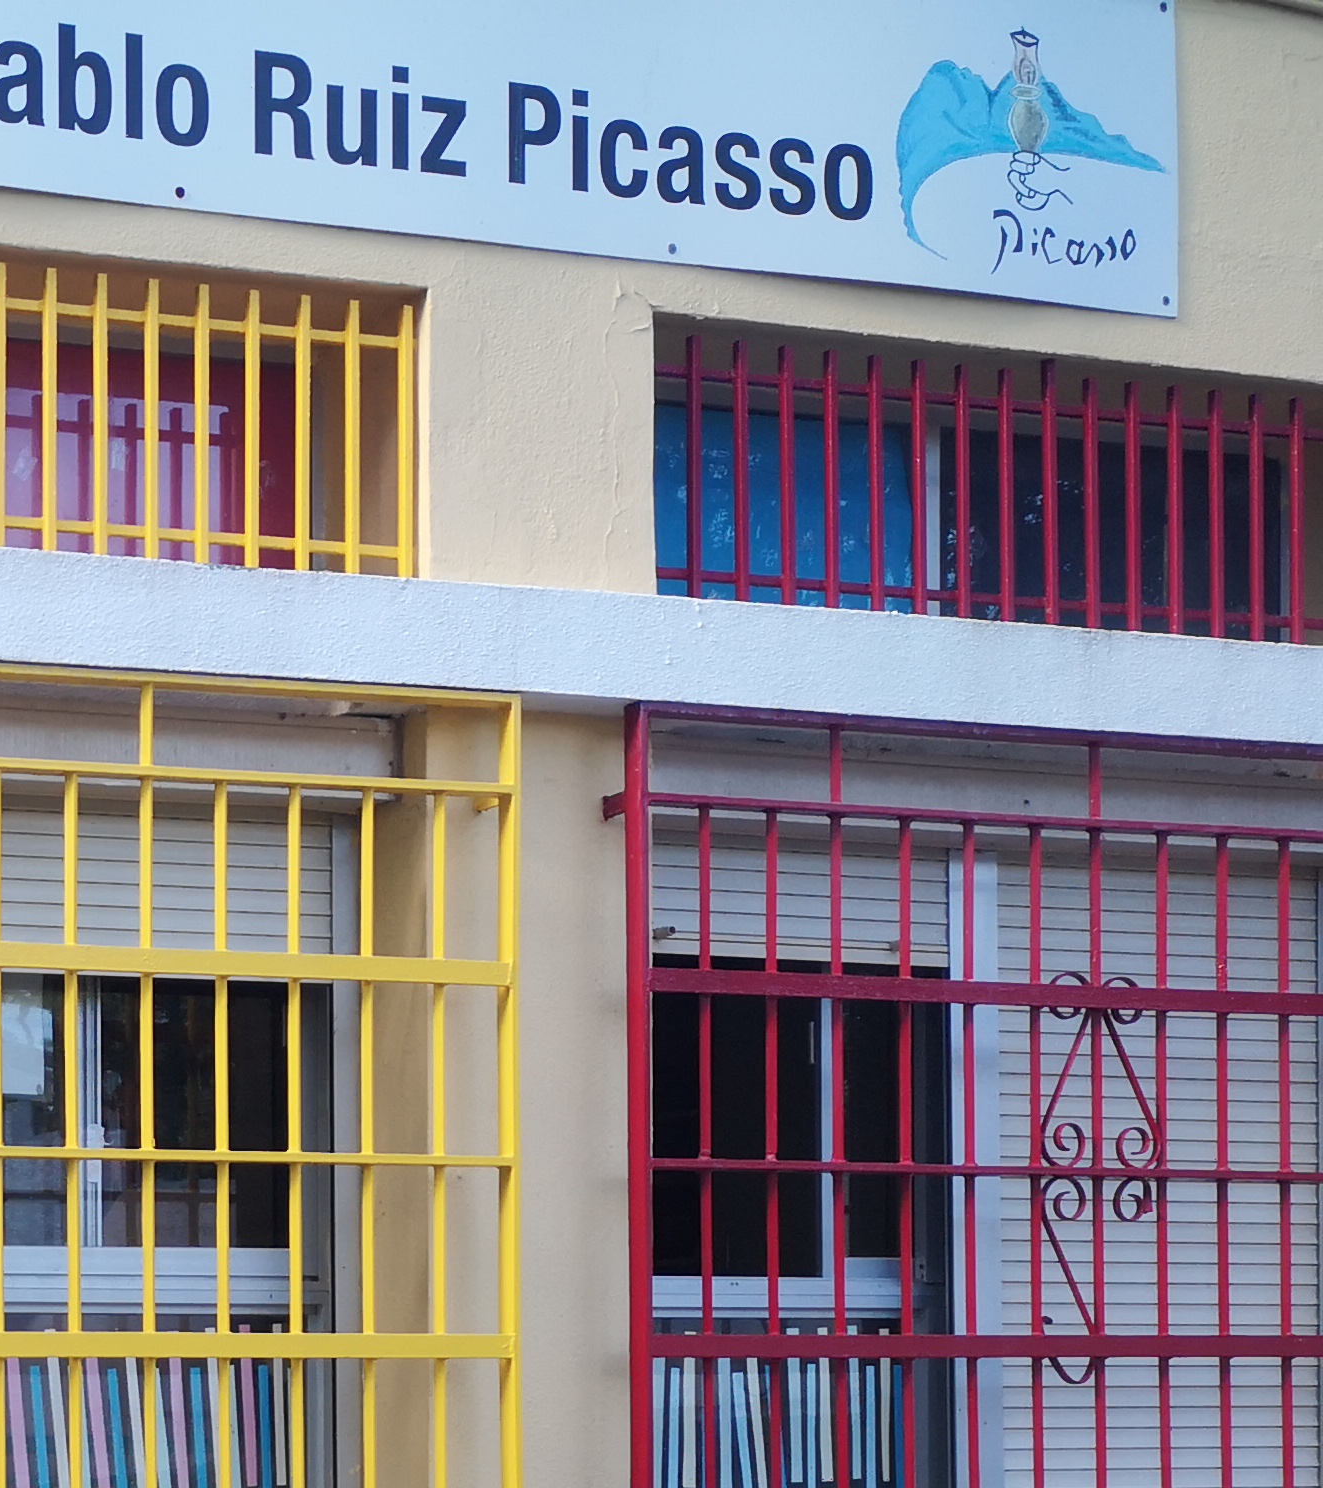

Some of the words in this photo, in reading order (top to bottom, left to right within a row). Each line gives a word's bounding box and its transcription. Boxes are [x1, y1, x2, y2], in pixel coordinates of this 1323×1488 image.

[254, 50, 467, 178] Ruiz
[508, 81, 874, 221] Picasso
[992, 209, 1138, 274] Picasso
